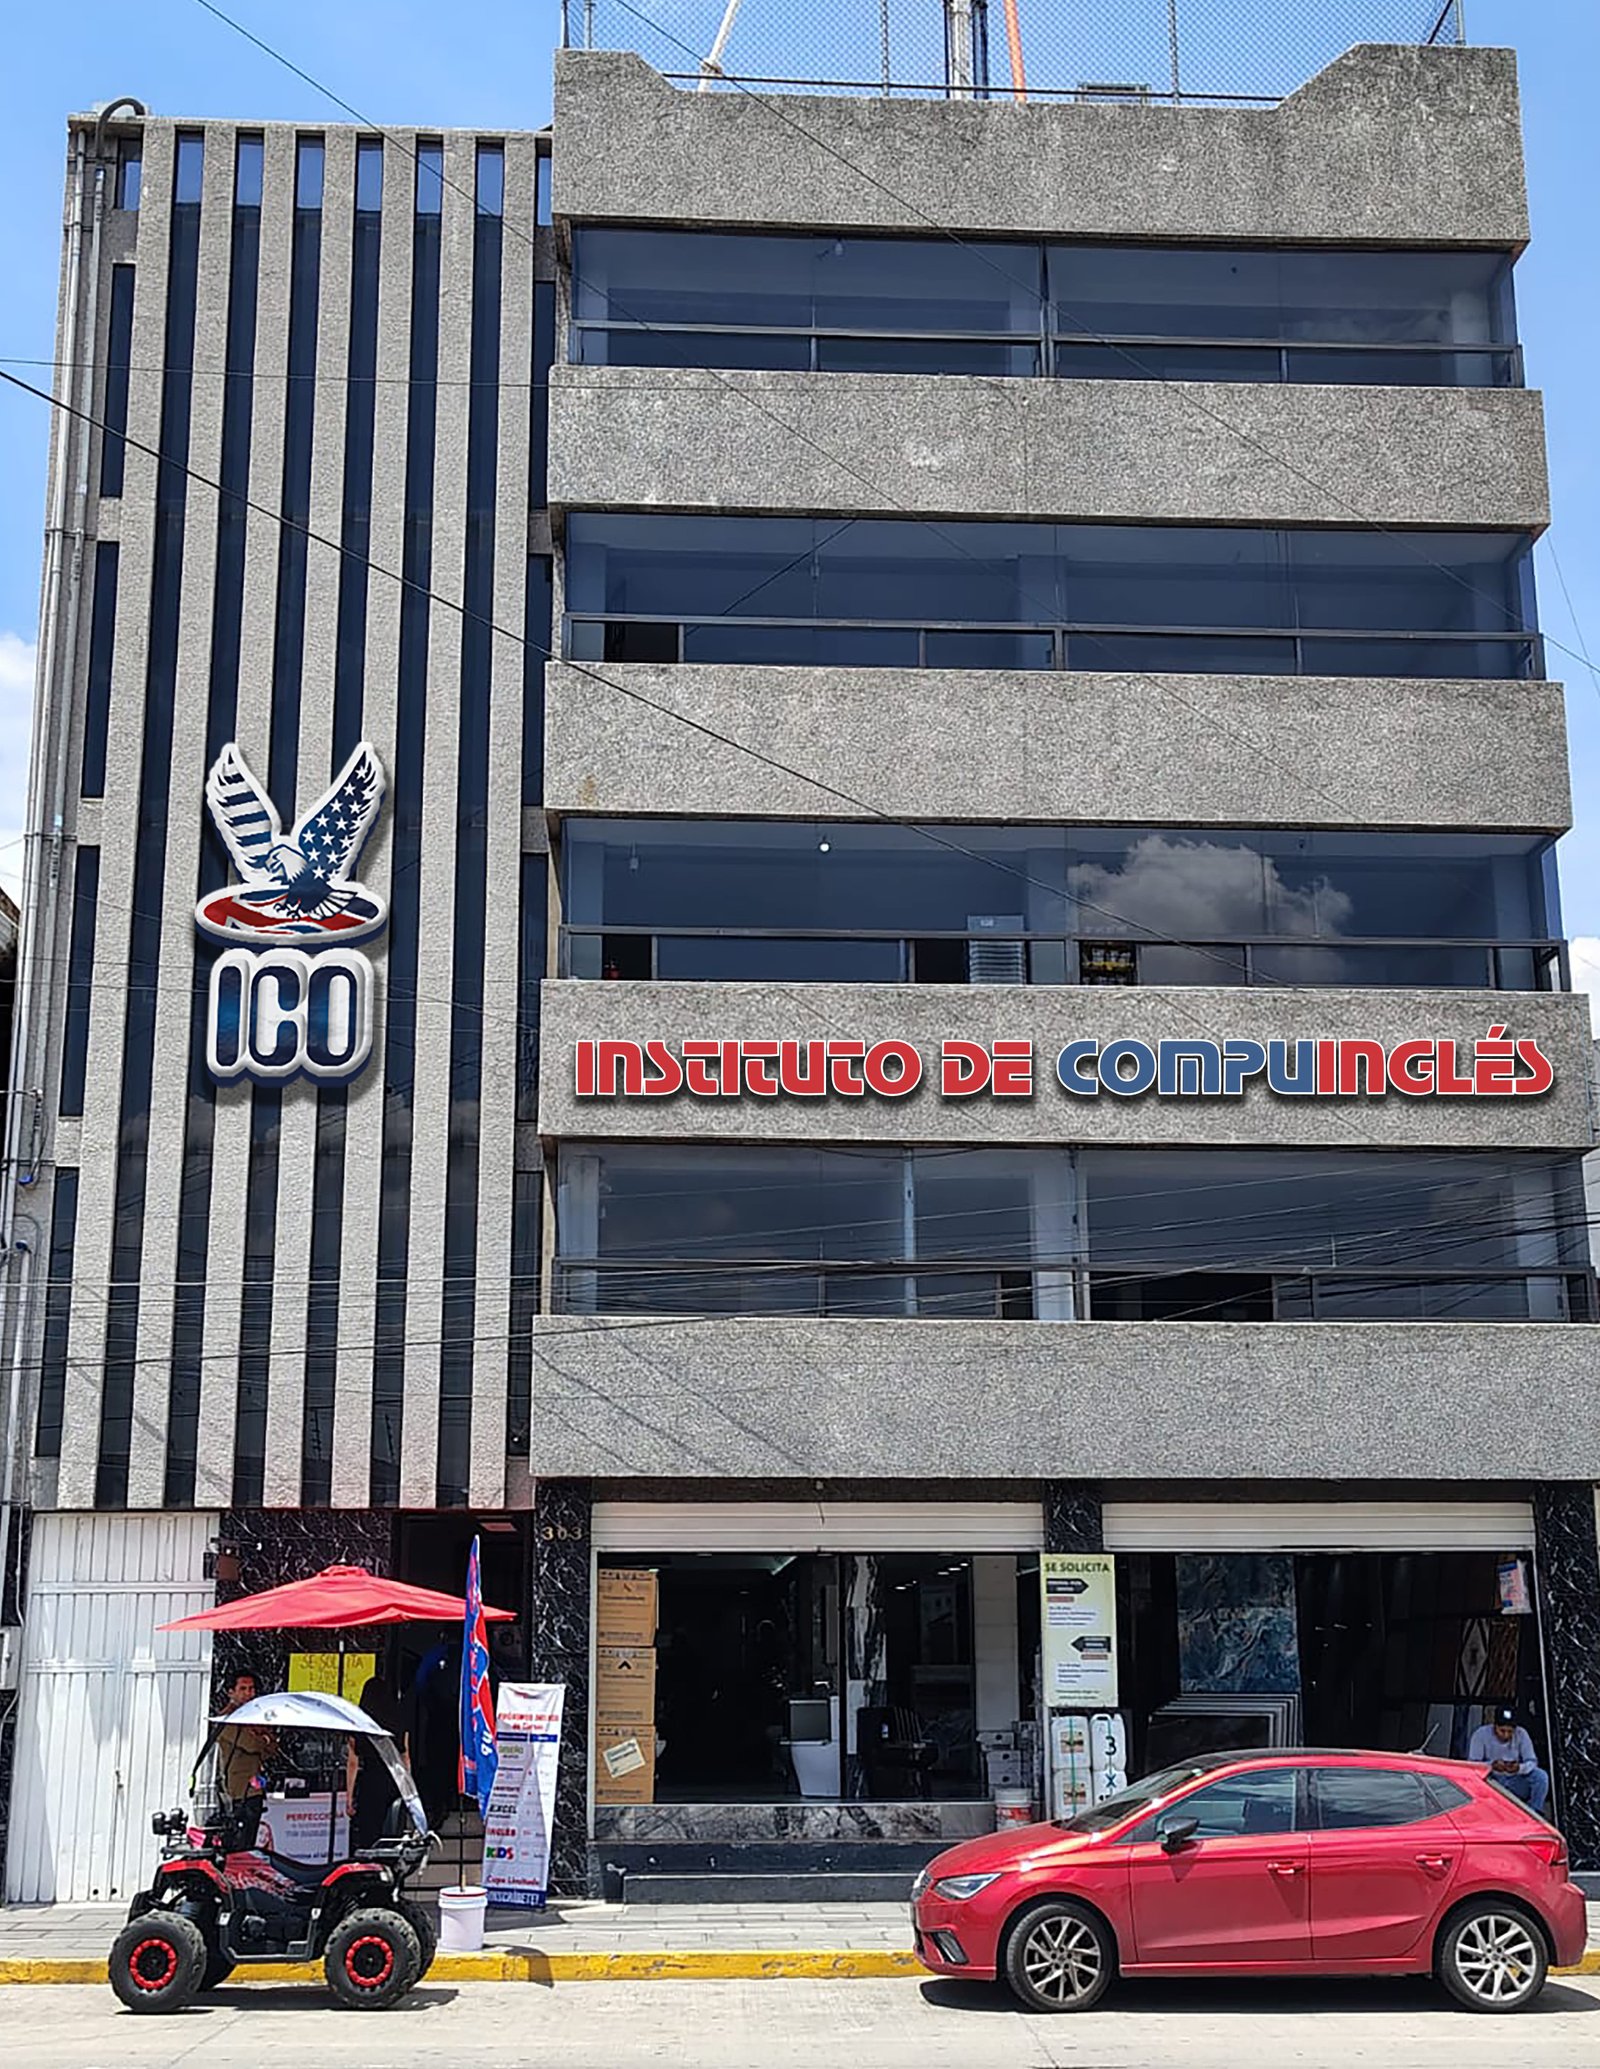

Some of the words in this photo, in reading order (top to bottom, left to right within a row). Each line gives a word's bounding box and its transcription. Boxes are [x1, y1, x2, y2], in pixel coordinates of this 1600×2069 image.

[214, 965, 358, 1067] ICO
[576, 1039, 922, 1096] INSTITUTO
[942, 1040, 1033, 1095] DE
[1057, 1023, 1553, 1096] COMPUINGLÉS
[1045, 1562, 1057, 1572] SE
[1060, 1562, 1110, 1572] SOLICITA
[319, 1654, 364, 1671] SOLITA
